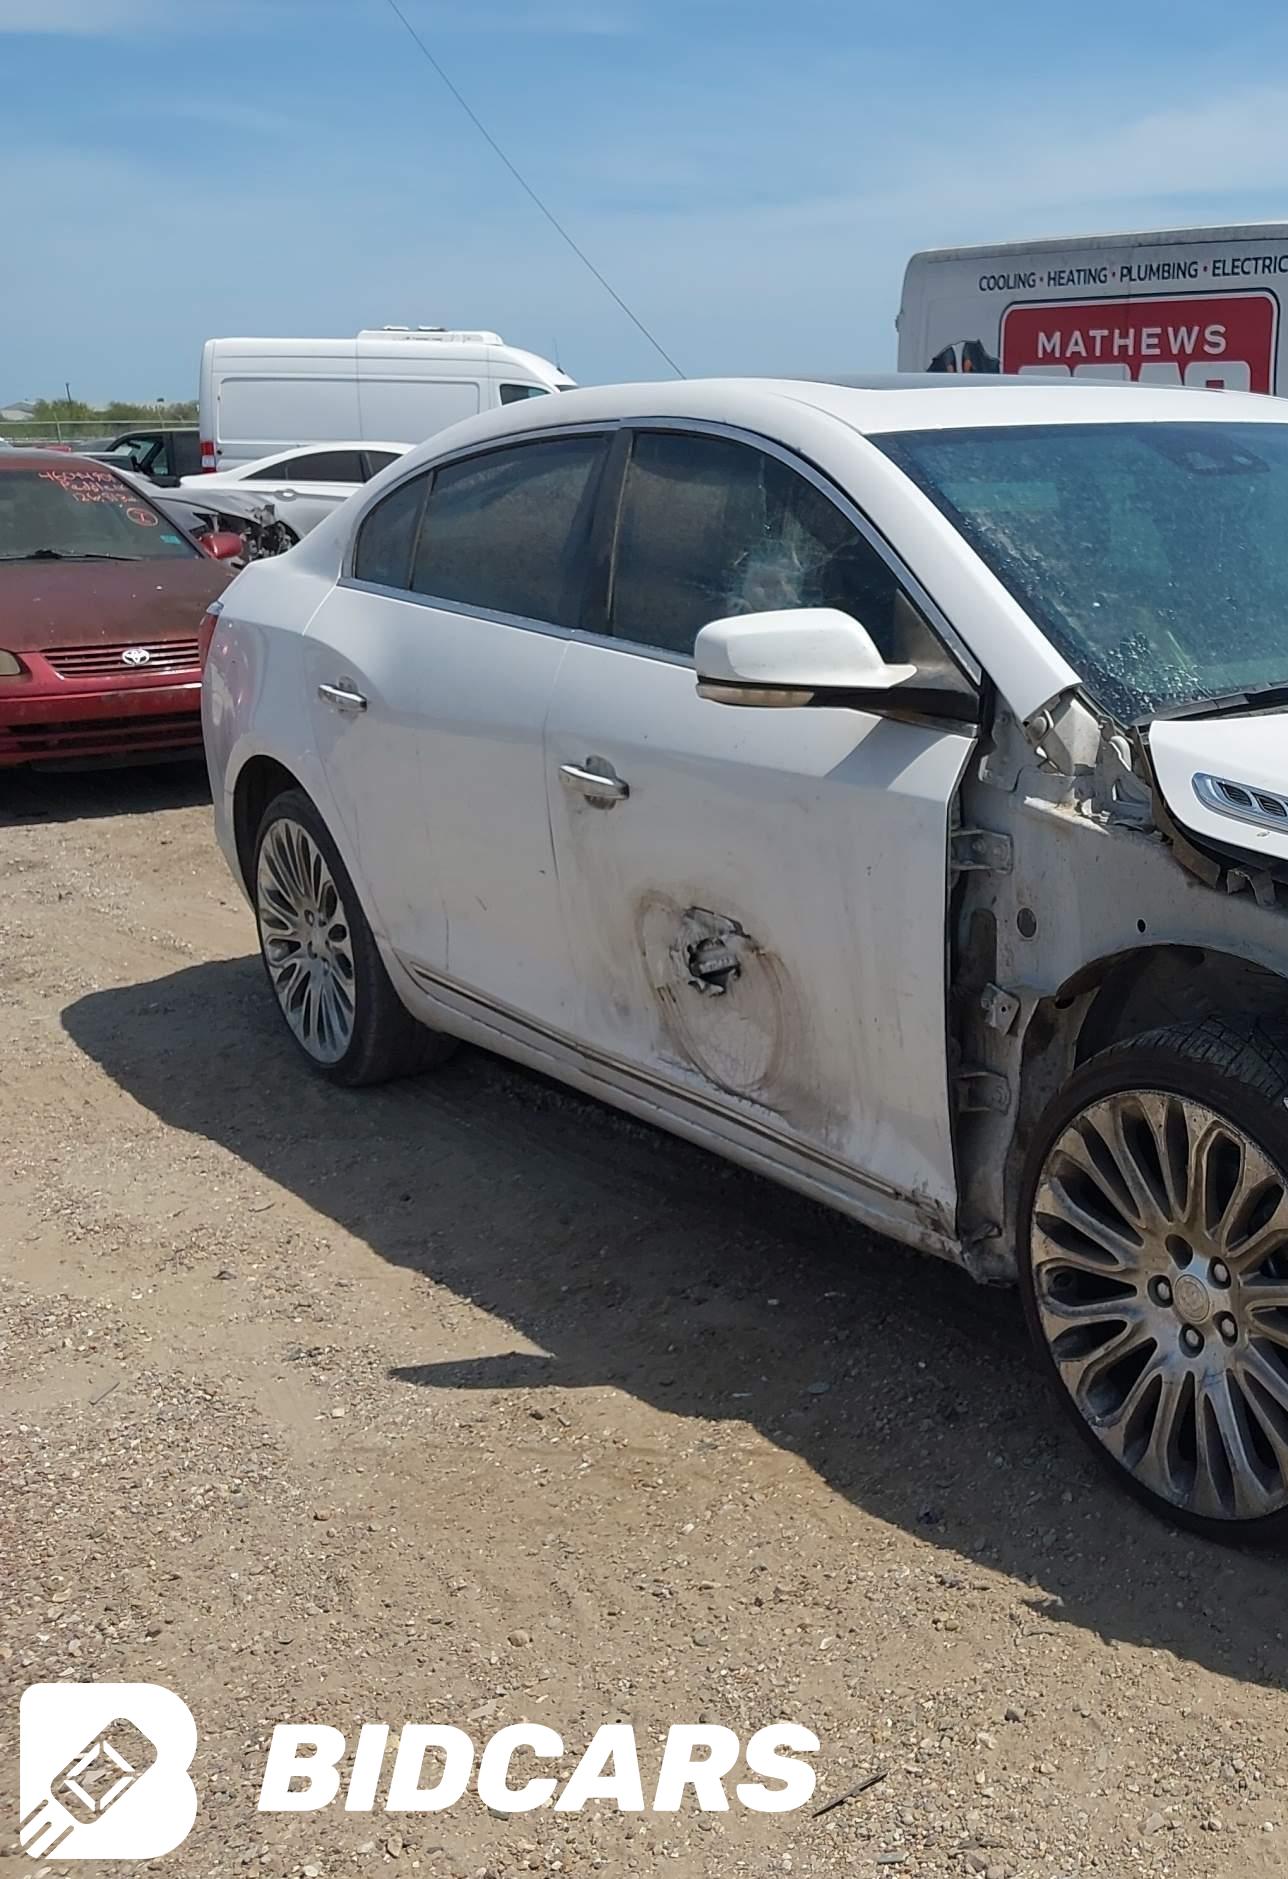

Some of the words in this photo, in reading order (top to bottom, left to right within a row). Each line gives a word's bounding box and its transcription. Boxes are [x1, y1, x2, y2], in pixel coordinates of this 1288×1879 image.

[979, 272, 1036, 291] COOLING
[1047, 267, 1108, 287] HEATING
[1120, 261, 1199, 282] PLUMBING
[1037, 324, 1226, 358] MATHEWS
